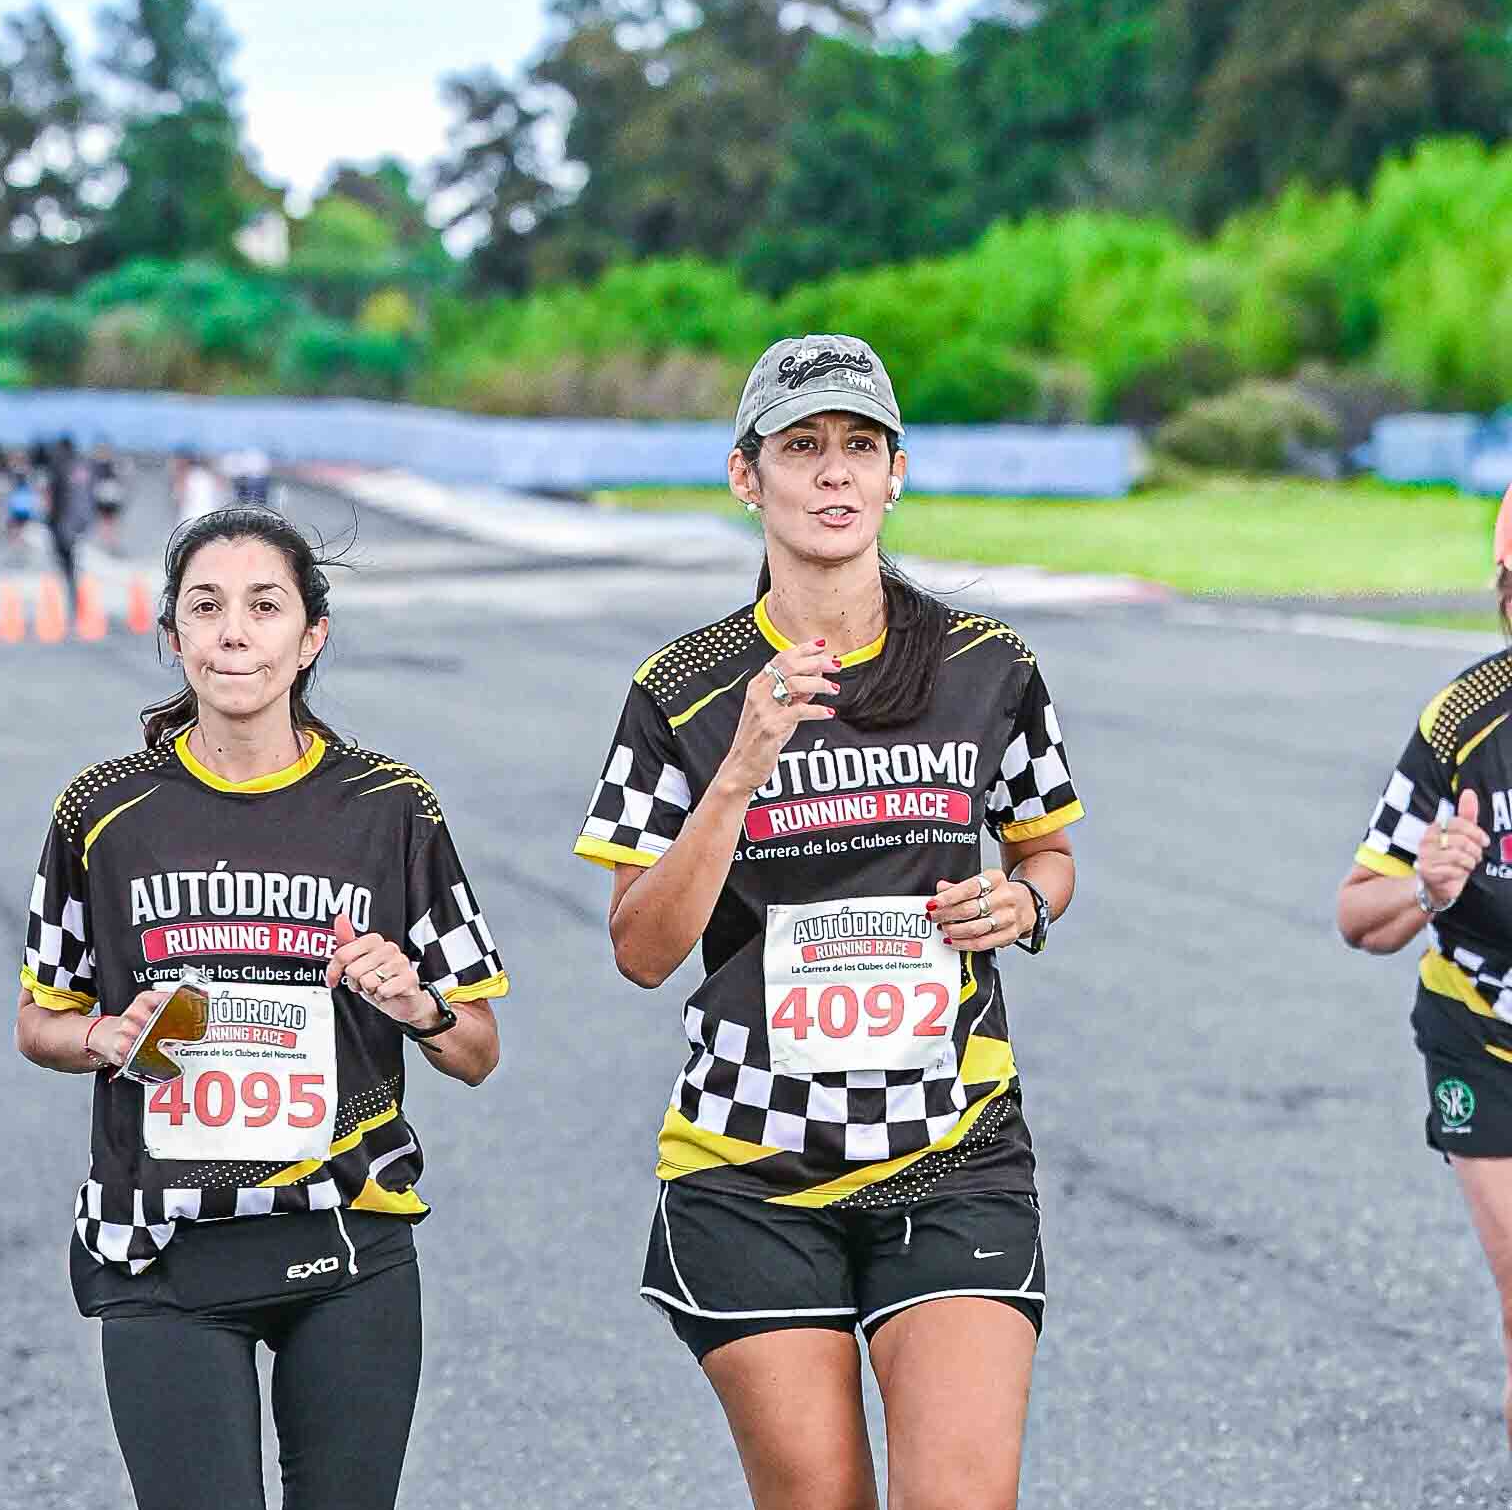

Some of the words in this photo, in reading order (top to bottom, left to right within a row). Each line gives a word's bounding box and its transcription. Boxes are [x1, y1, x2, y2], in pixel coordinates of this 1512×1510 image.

[751, 739, 979, 802] UTÓDROMO
[768, 795, 878, 835] RUNNING
[885, 792, 950, 819] RACE
[745, 844, 801, 860] Carrera
[803, 840, 823, 856] de
[825, 838, 848, 854] los
[850, 833, 903, 851] Clubes
[905, 829, 929, 845] del
[130, 860, 372, 933] AUTÓDROMO
[164, 925, 272, 956] RUNNING
[277, 927, 337, 960] RACE
[794, 907, 932, 944] AUTÓDROMO
[791, 965, 801, 973] La
[801, 965, 831, 973] Carrera
[832, 963, 843, 972] de
[844, 963, 856, 971] los
[857, 962, 884, 971] Clubes
[884, 961, 897, 970] del
[815, 941, 873, 961] RUNNING
[875, 940, 908, 956] RACE
[217, 964, 239, 980] los
[241, 965, 292, 981] Clubes
[294, 967, 317, 982] del
[208, 990, 306, 1030] TÓDROMO
[772, 982, 949, 1040] 4092
[209, 1047, 220, 1057] de
[222, 1047, 234, 1057] los
[235, 1048, 260, 1058] Clubes
[262, 1050, 273, 1058] del
[252, 1027, 285, 1045] RACE
[149, 1070, 327, 1128] 4095
[286, 1256, 339, 1279] EXO
